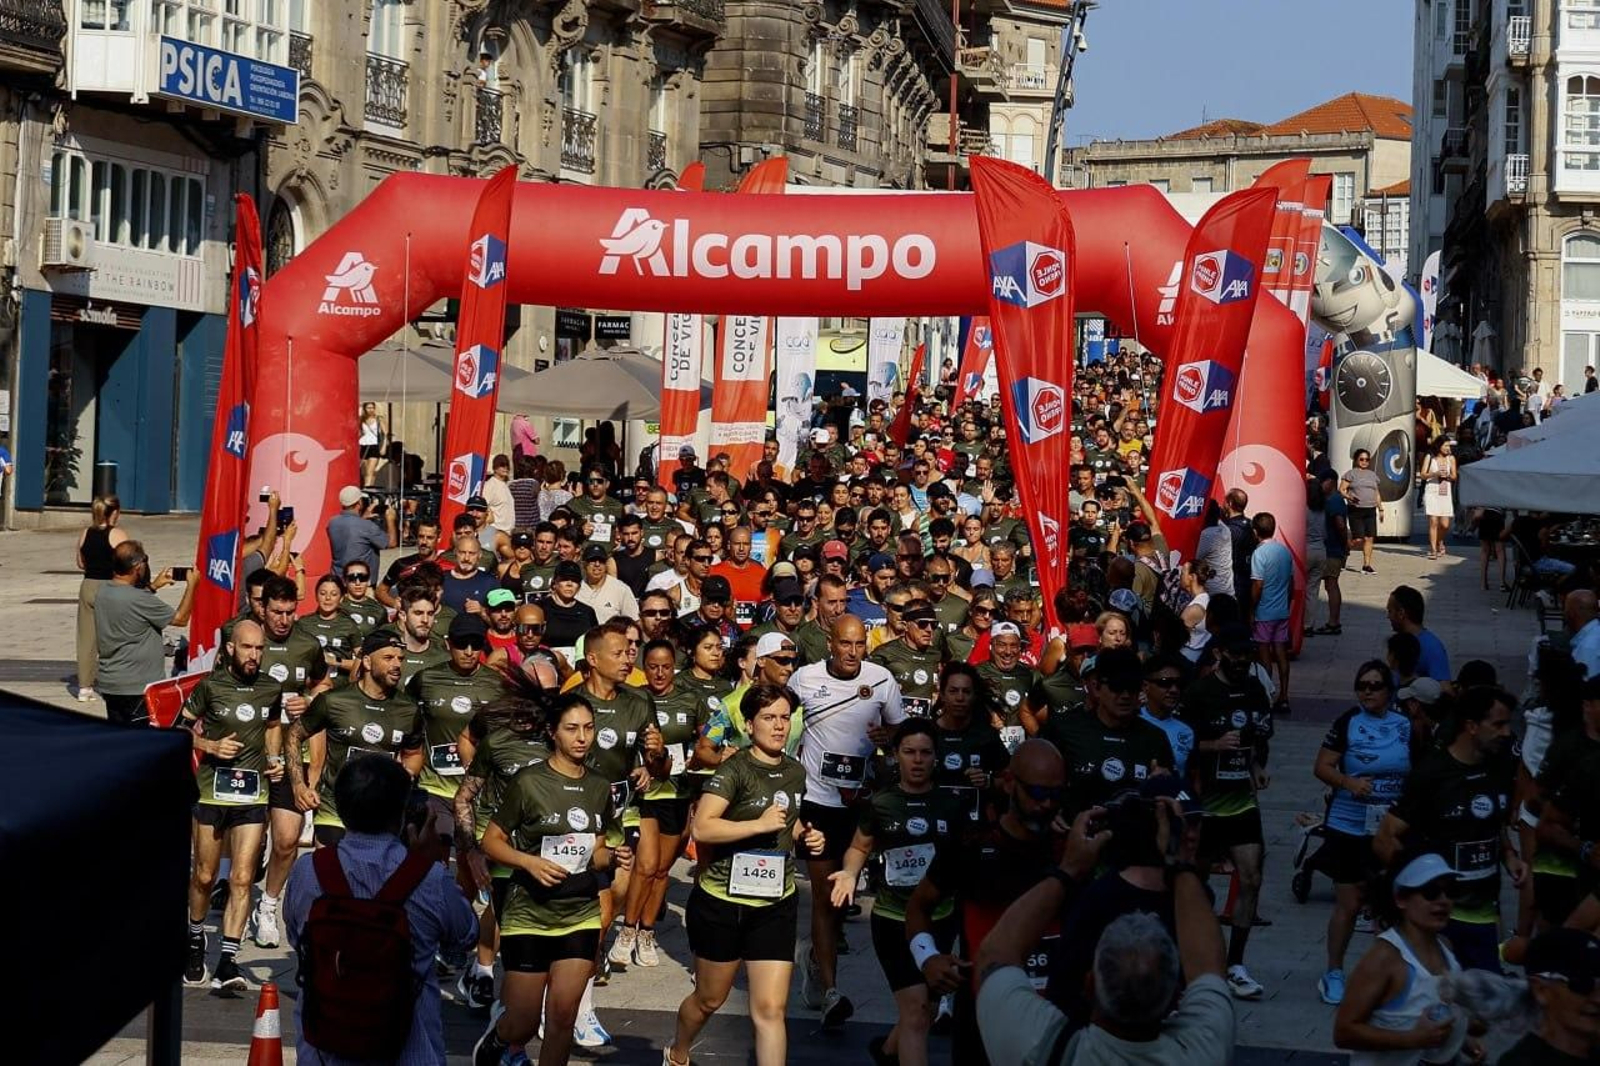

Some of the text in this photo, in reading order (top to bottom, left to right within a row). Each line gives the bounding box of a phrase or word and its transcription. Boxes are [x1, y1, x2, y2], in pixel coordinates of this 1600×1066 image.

[161, 42, 243, 106] PSICA
[599, 207, 937, 291] Alcampo
[1220, 279, 1248, 299] AXA
[318, 302, 381, 318] Alcampo
[679, 348, 691, 371] DE
[1203, 389, 1228, 409] AXA
[208, 558, 231, 582] AXA
[446, 753, 460, 762] 91
[836, 764, 852, 773] 89
[230, 779, 245, 788] 38
[553, 845, 586, 856] 1452
[894, 856, 926, 870] 1428
[742, 866, 776, 879] 1426
